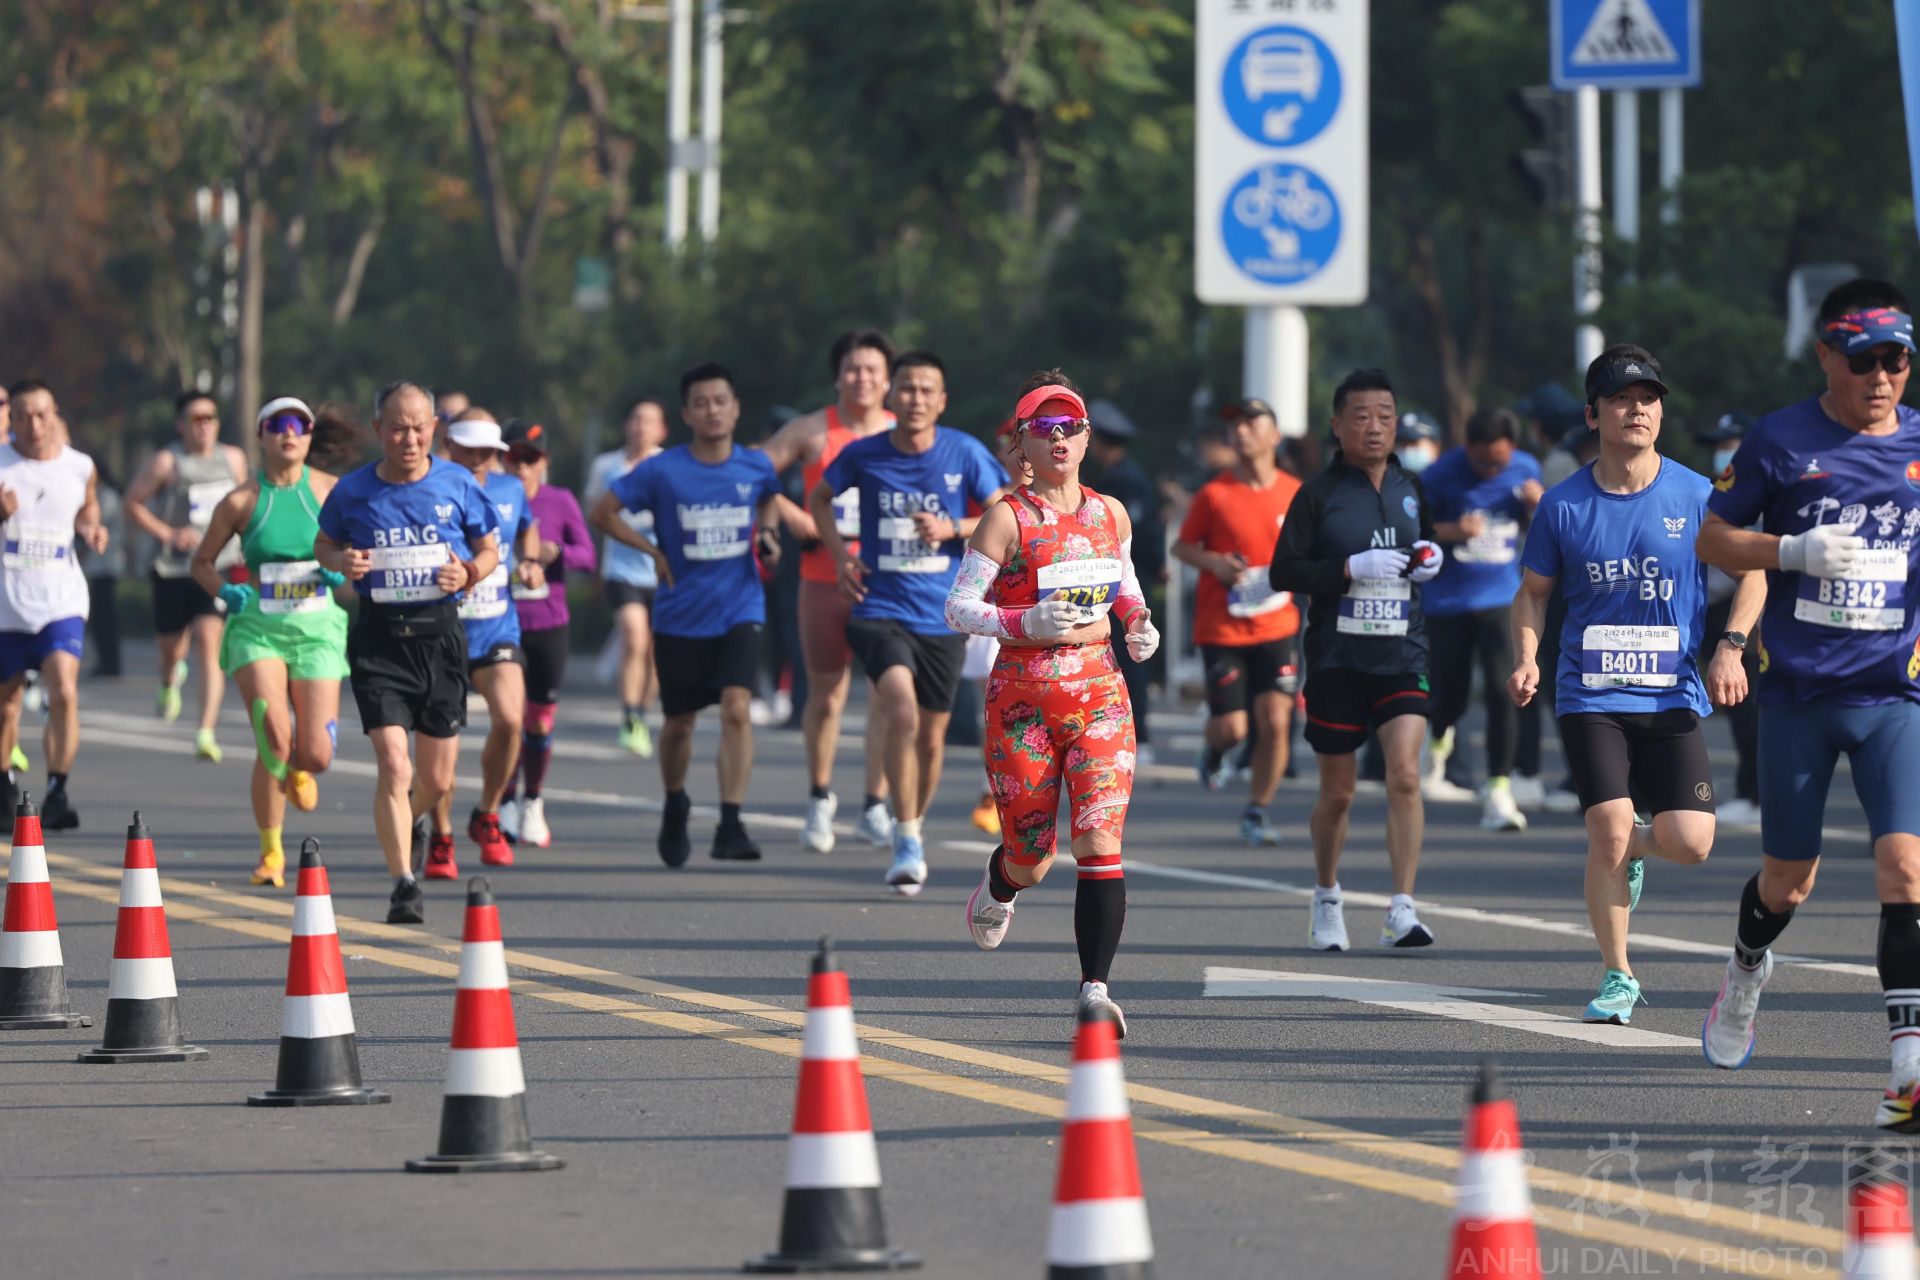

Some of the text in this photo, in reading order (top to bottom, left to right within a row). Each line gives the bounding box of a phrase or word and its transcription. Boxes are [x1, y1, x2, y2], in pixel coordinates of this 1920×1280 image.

[879, 491, 940, 512] BENG
[373, 524, 439, 546] BENG
[384, 567, 433, 587] B3172
[1586, 556, 1659, 583] BENG
[1640, 578, 1674, 601] BU
[1819, 579, 1887, 608] B3342
[1353, 601, 1402, 619] B3364
[1601, 652, 1658, 673] B4011
